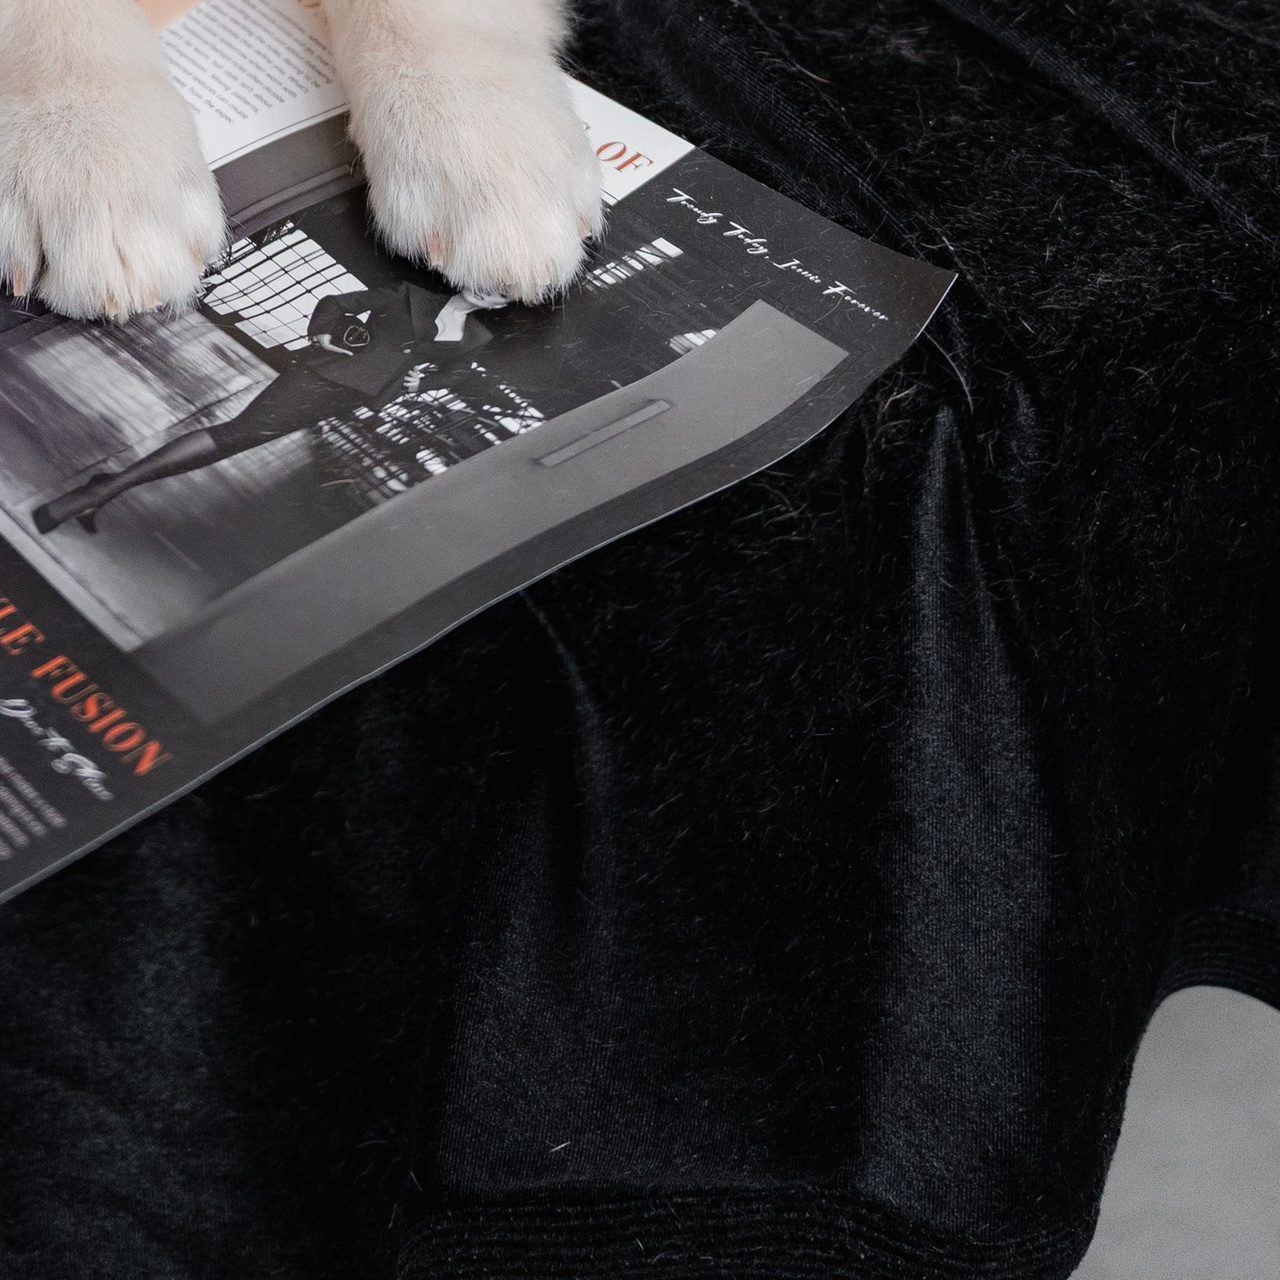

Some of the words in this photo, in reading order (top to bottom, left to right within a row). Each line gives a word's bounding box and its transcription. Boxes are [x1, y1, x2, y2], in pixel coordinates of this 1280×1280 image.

[596, 141, 653, 173] OF
[666, 187, 722, 223] Trendy
[30, 655, 170, 775] FUSION
